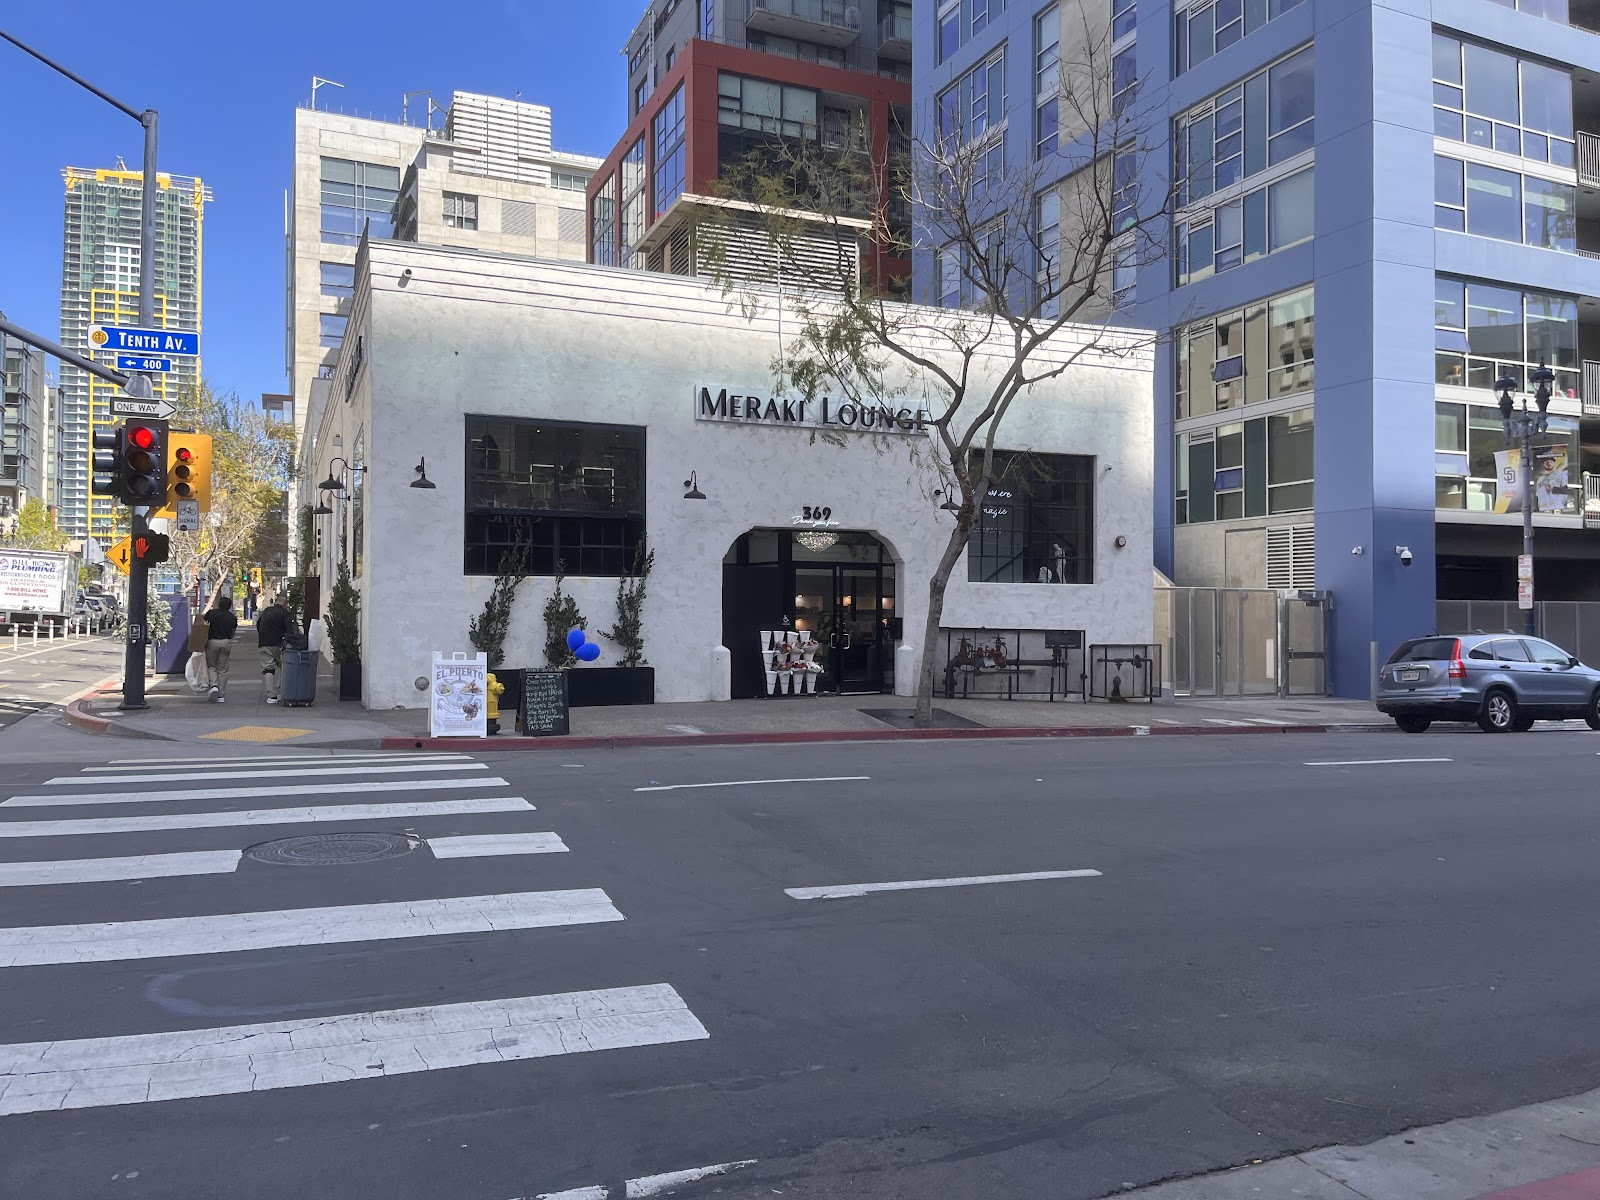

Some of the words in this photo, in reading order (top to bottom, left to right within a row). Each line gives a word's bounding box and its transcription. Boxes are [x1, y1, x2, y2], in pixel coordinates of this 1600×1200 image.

[119, 332, 159, 349] TENTH
[165, 336, 187, 351] AV.
[143, 360, 162, 370] 400
[116, 403, 135, 412] ONE
[138, 404, 158, 413] WAY
[701, 387, 805, 423] MERAKI
[822, 397, 929, 431] LOUNGE
[802, 506, 832, 521] 369
[436, 669, 447, 680] EL
[449, 667, 484, 681] PUERTO
